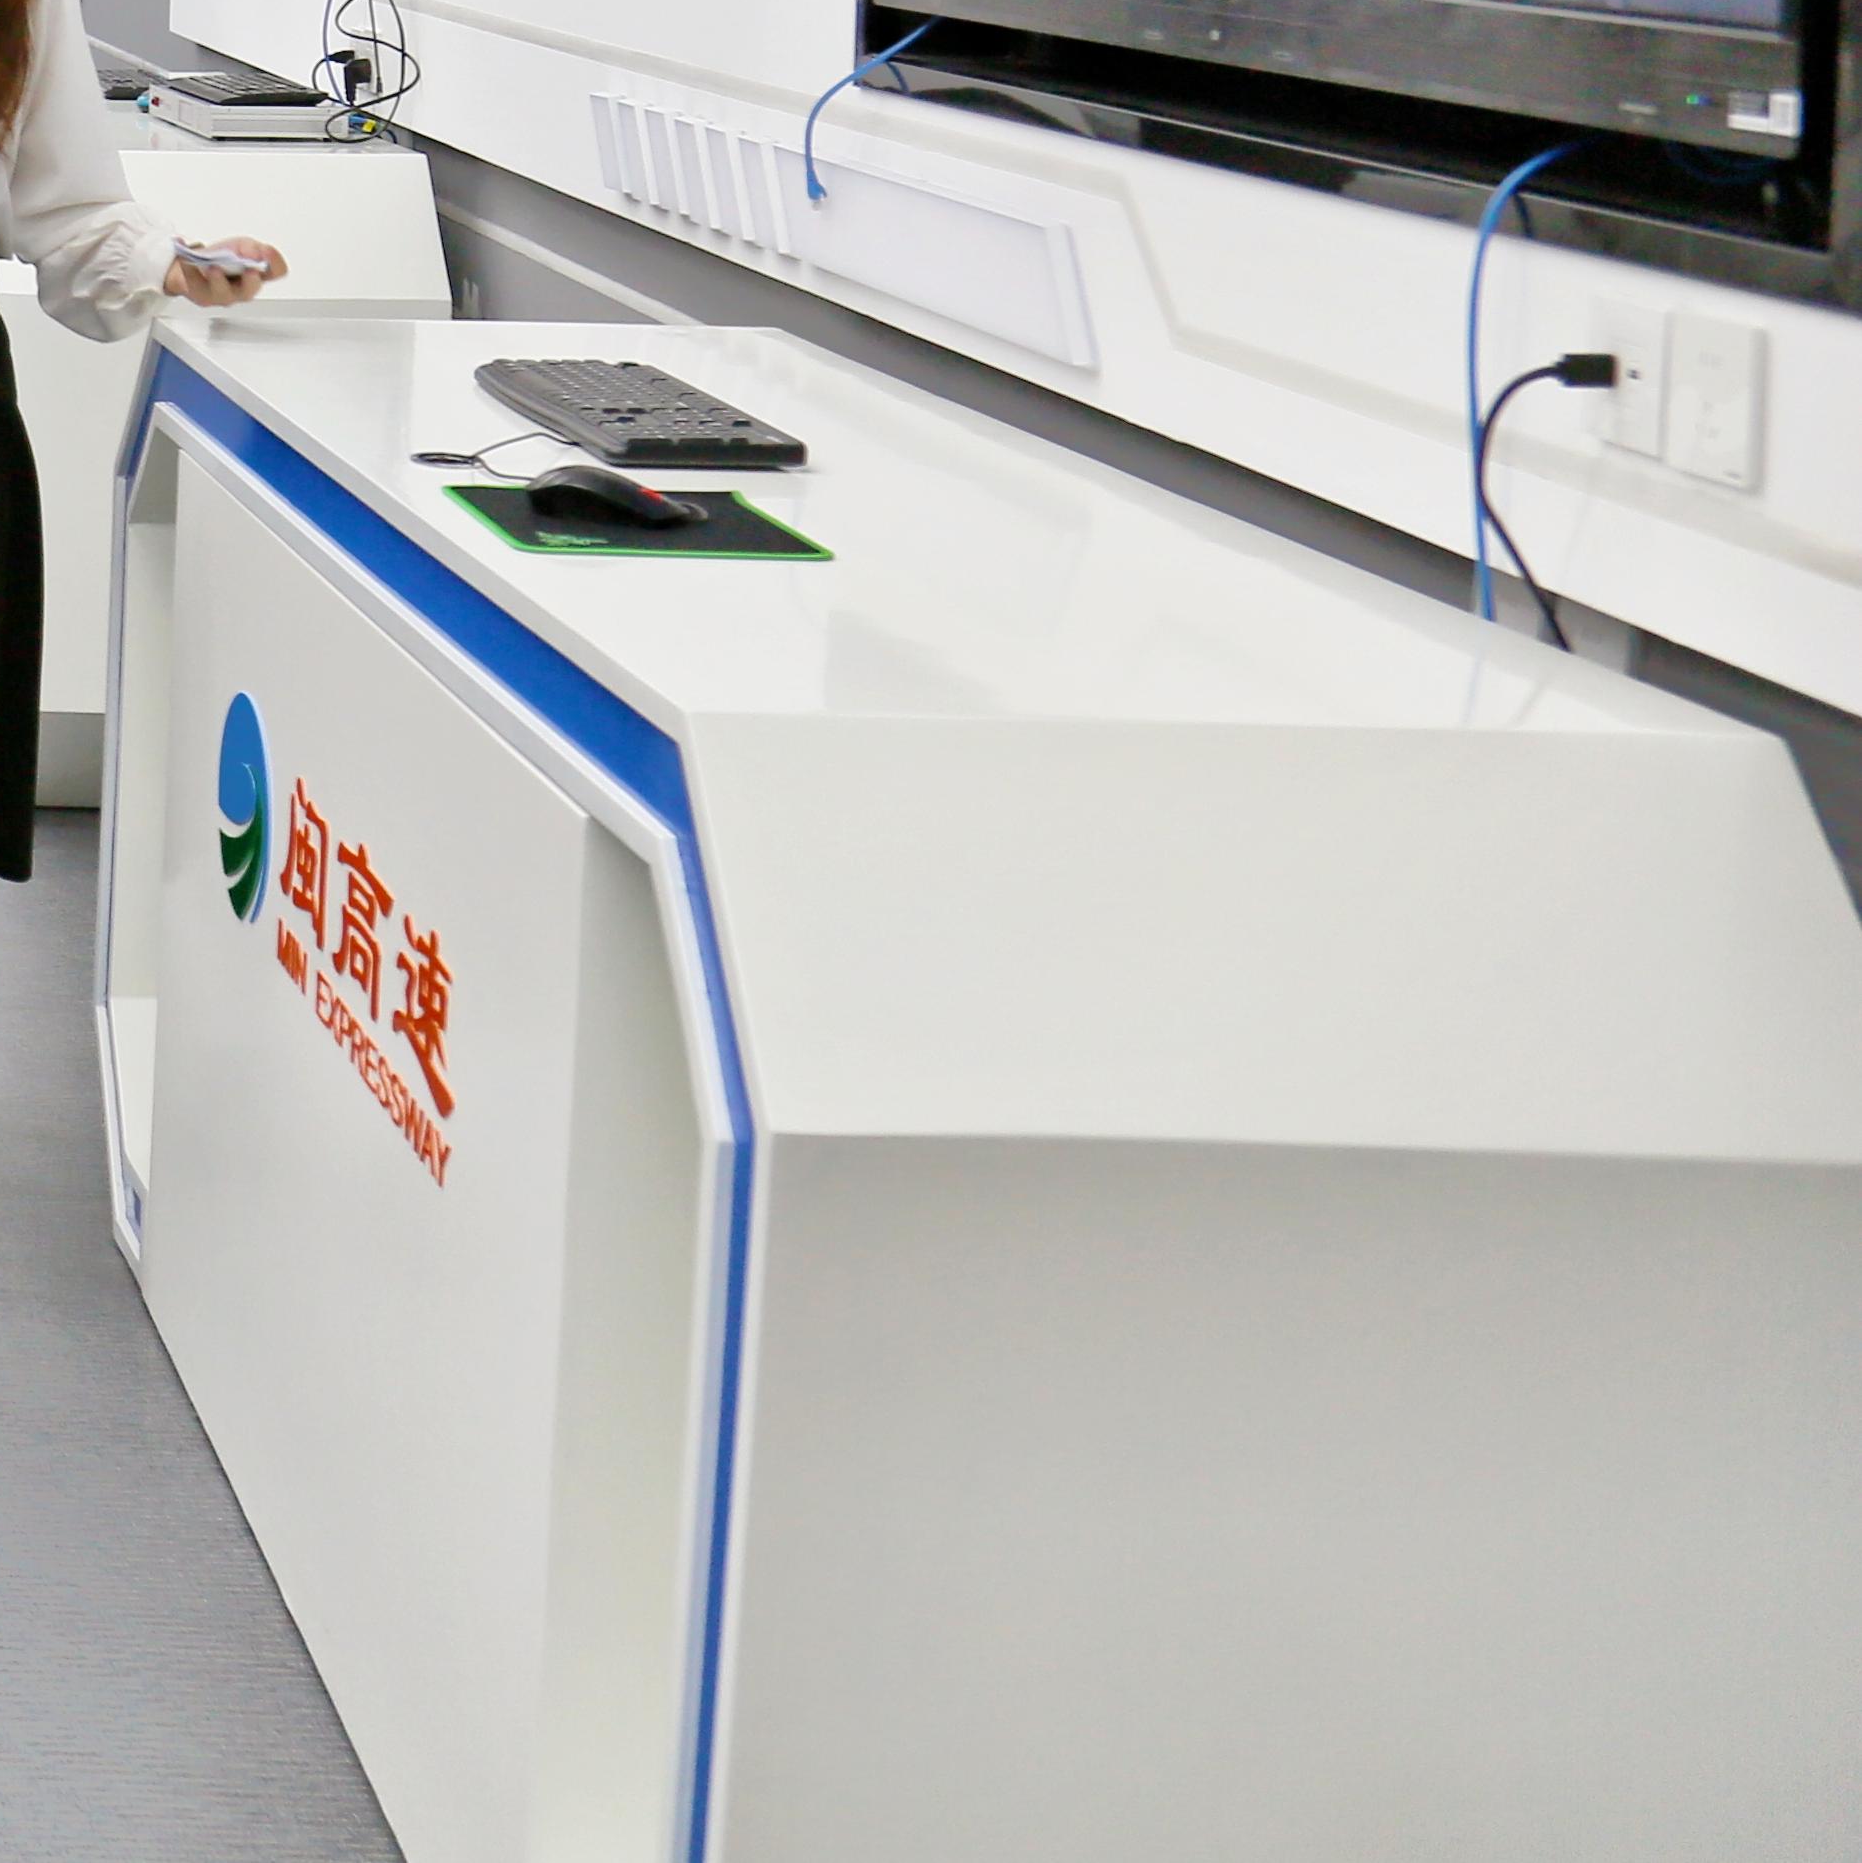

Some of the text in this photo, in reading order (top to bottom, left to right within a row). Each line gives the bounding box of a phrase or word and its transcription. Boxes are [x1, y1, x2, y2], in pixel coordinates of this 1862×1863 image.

[276, 917, 452, 1188] MIN EXPRESSWAY
[280, 777, 456, 1120] 闽高速
